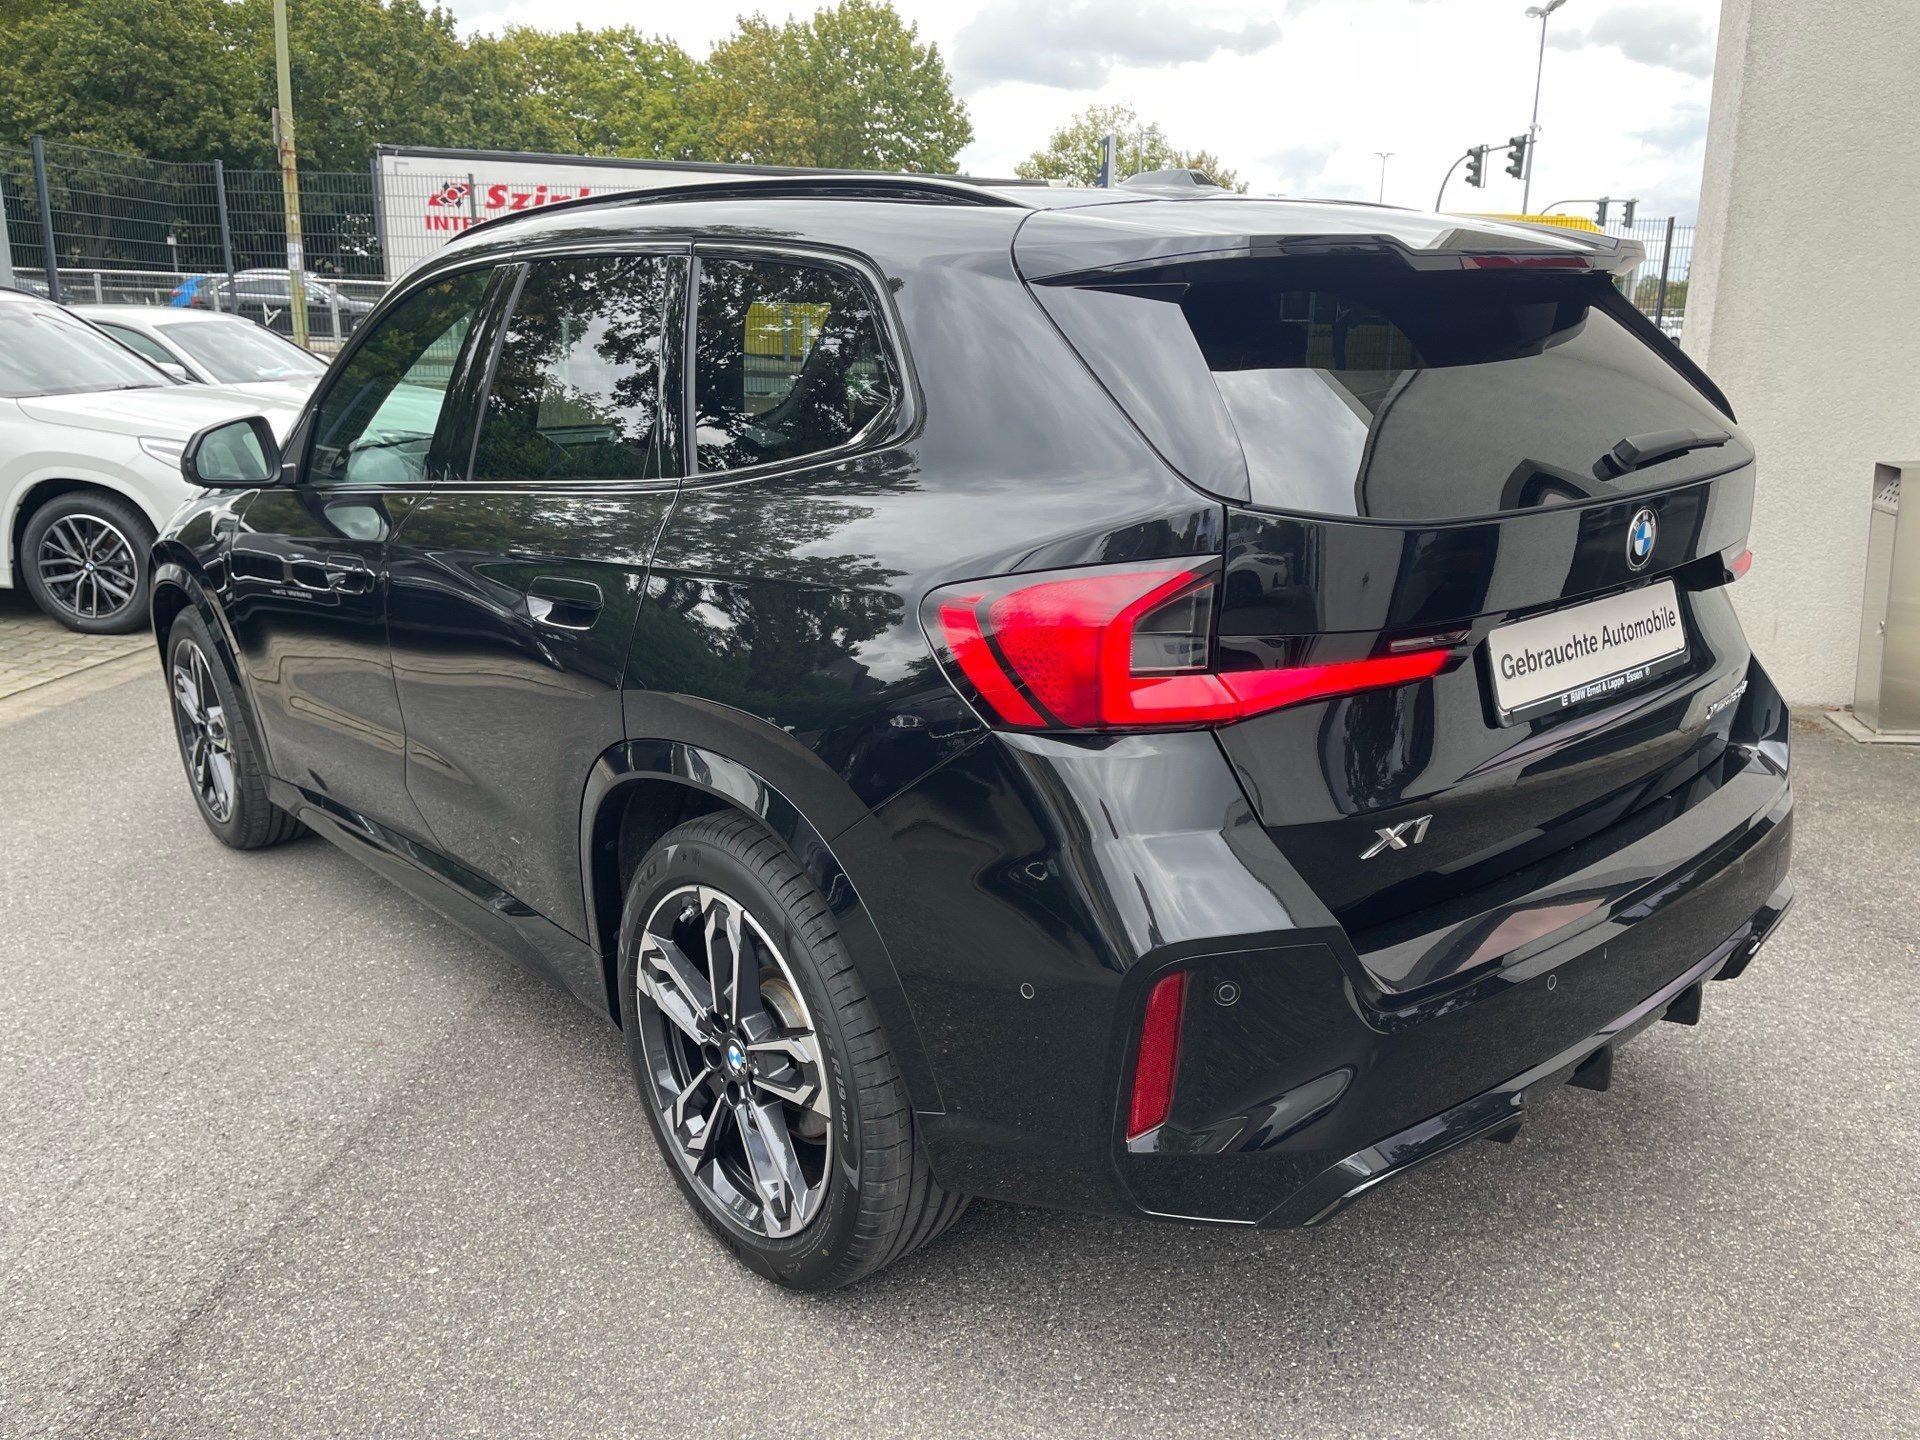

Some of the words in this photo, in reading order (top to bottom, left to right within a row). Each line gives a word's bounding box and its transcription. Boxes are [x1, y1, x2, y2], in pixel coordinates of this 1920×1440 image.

[1501, 634, 1598, 679] Gebrauchte
[1602, 607, 1676, 649] Automobile
[1570, 689, 1586, 703] BMW
[1586, 683, 1602, 697] Ernst
[1602, 681, 1607, 691] &
[1607, 676, 1625, 690] Lappe
[1626, 670, 1643, 683] Essen
[1360, 814, 1434, 860] X1
